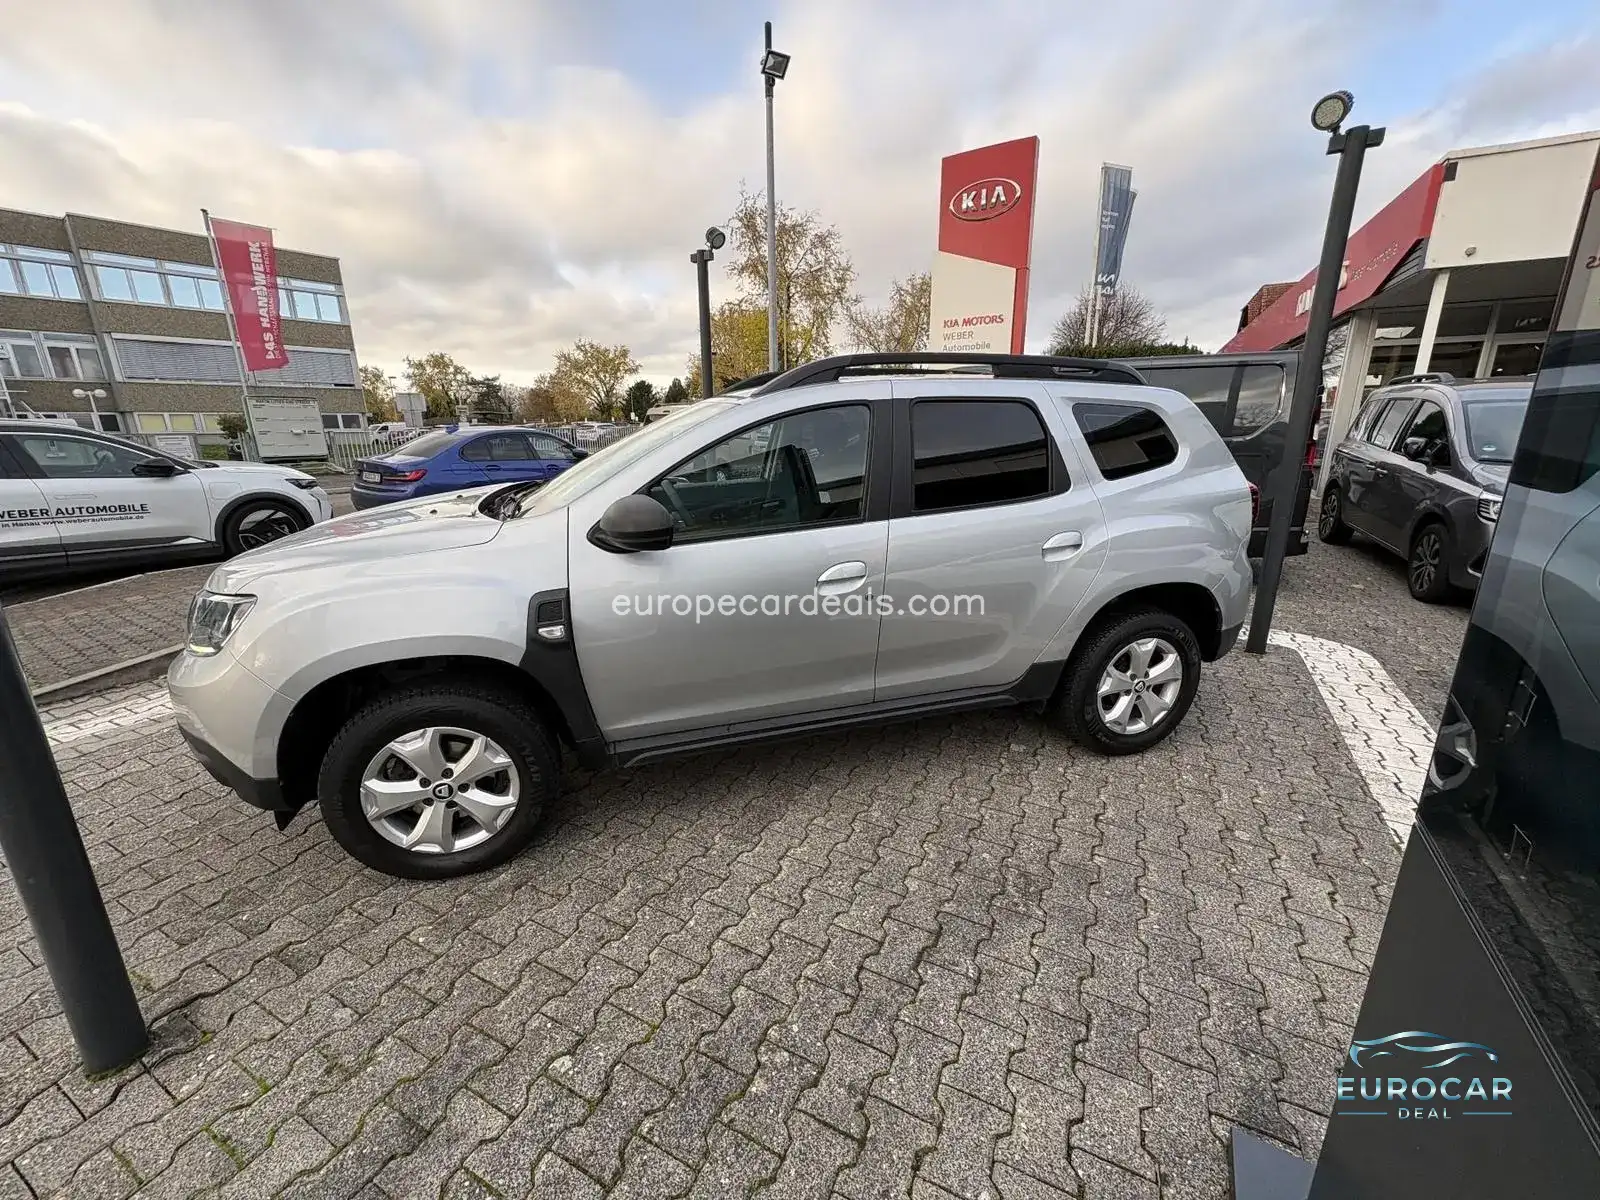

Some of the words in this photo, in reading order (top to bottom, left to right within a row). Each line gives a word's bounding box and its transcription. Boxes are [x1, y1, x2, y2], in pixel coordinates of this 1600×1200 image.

[961, 185, 1008, 213] KIA
[248, 241, 271, 328] HANDWERK
[943, 318, 960, 329] KIA
[961, 314, 1004, 327] MOTORS
[943, 331, 974, 341] WEBER
[263, 331, 275, 360] DAS
[943, 341, 991, 352] Automobile
[55, 503, 149, 516] AUTOMOBILE
[12, 520, 40, 528] Hanau
[41, 514, 144, 525] www.weberautomobile.de
